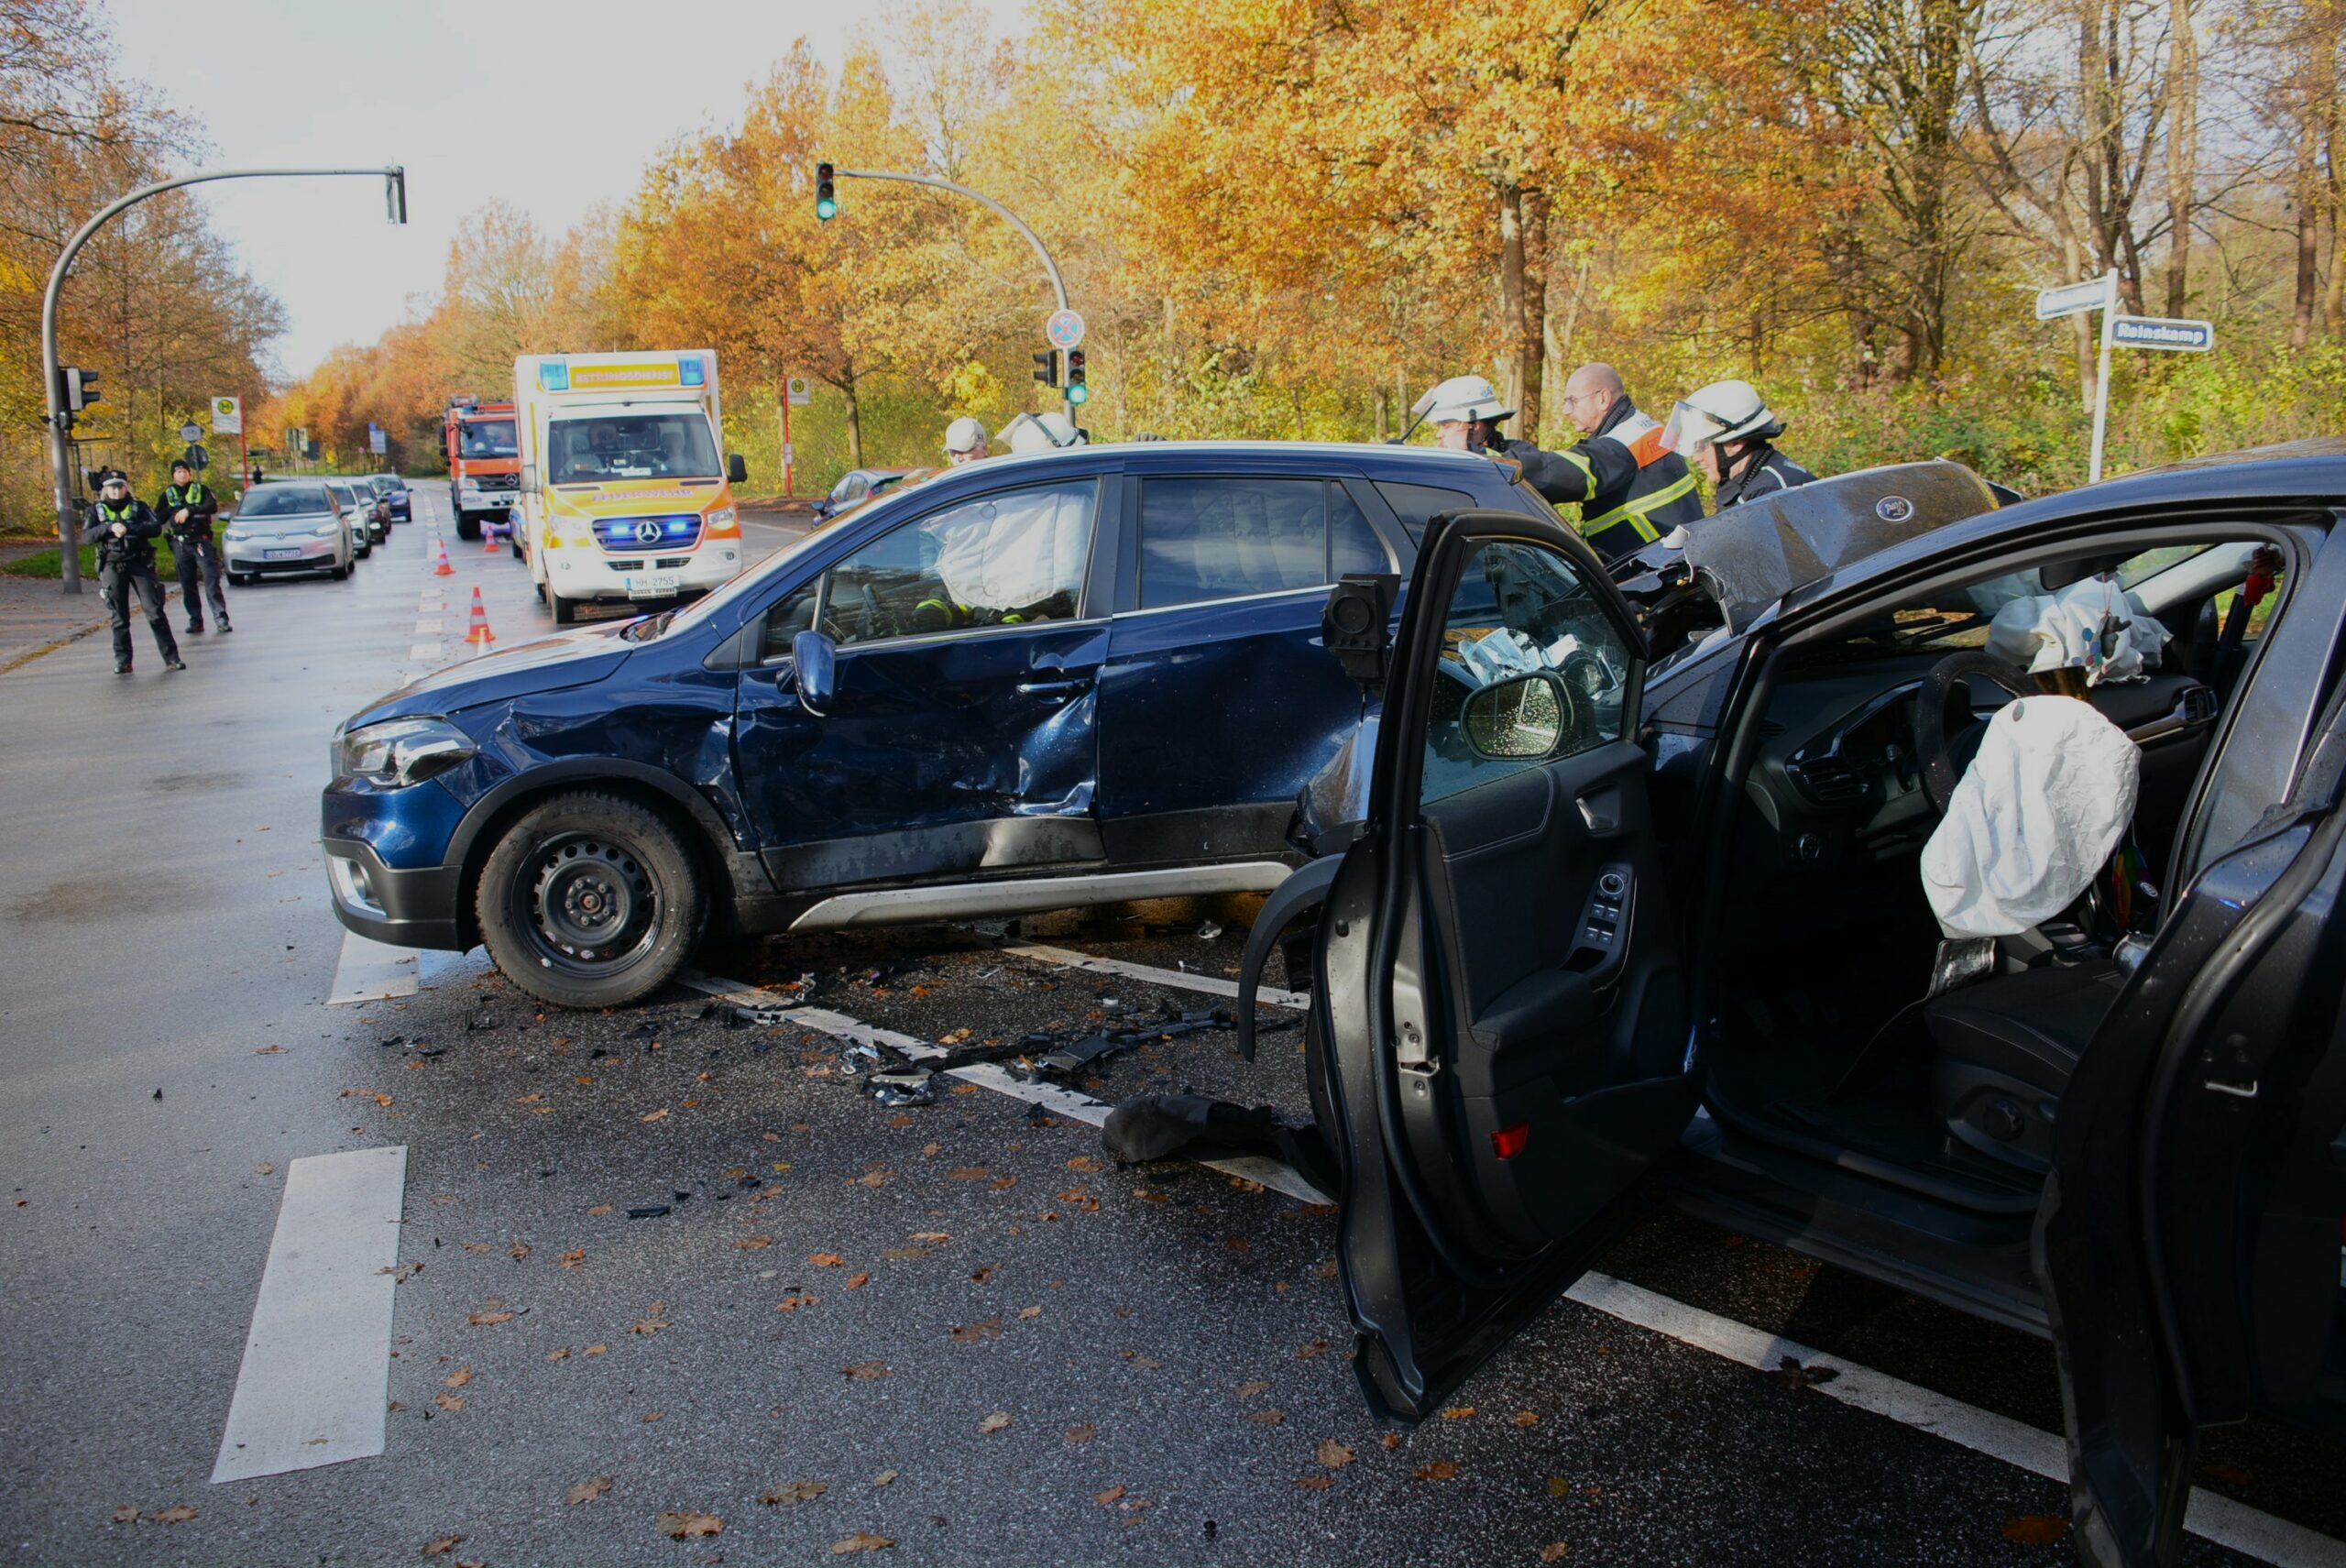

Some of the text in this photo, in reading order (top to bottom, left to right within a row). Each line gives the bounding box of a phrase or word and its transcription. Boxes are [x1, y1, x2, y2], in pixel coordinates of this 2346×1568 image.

[2117, 323, 2204, 345] Reinskamp
[576, 370, 674, 383] RETTUNGSDIENST
[635, 576, 674, 587] HH 2755
